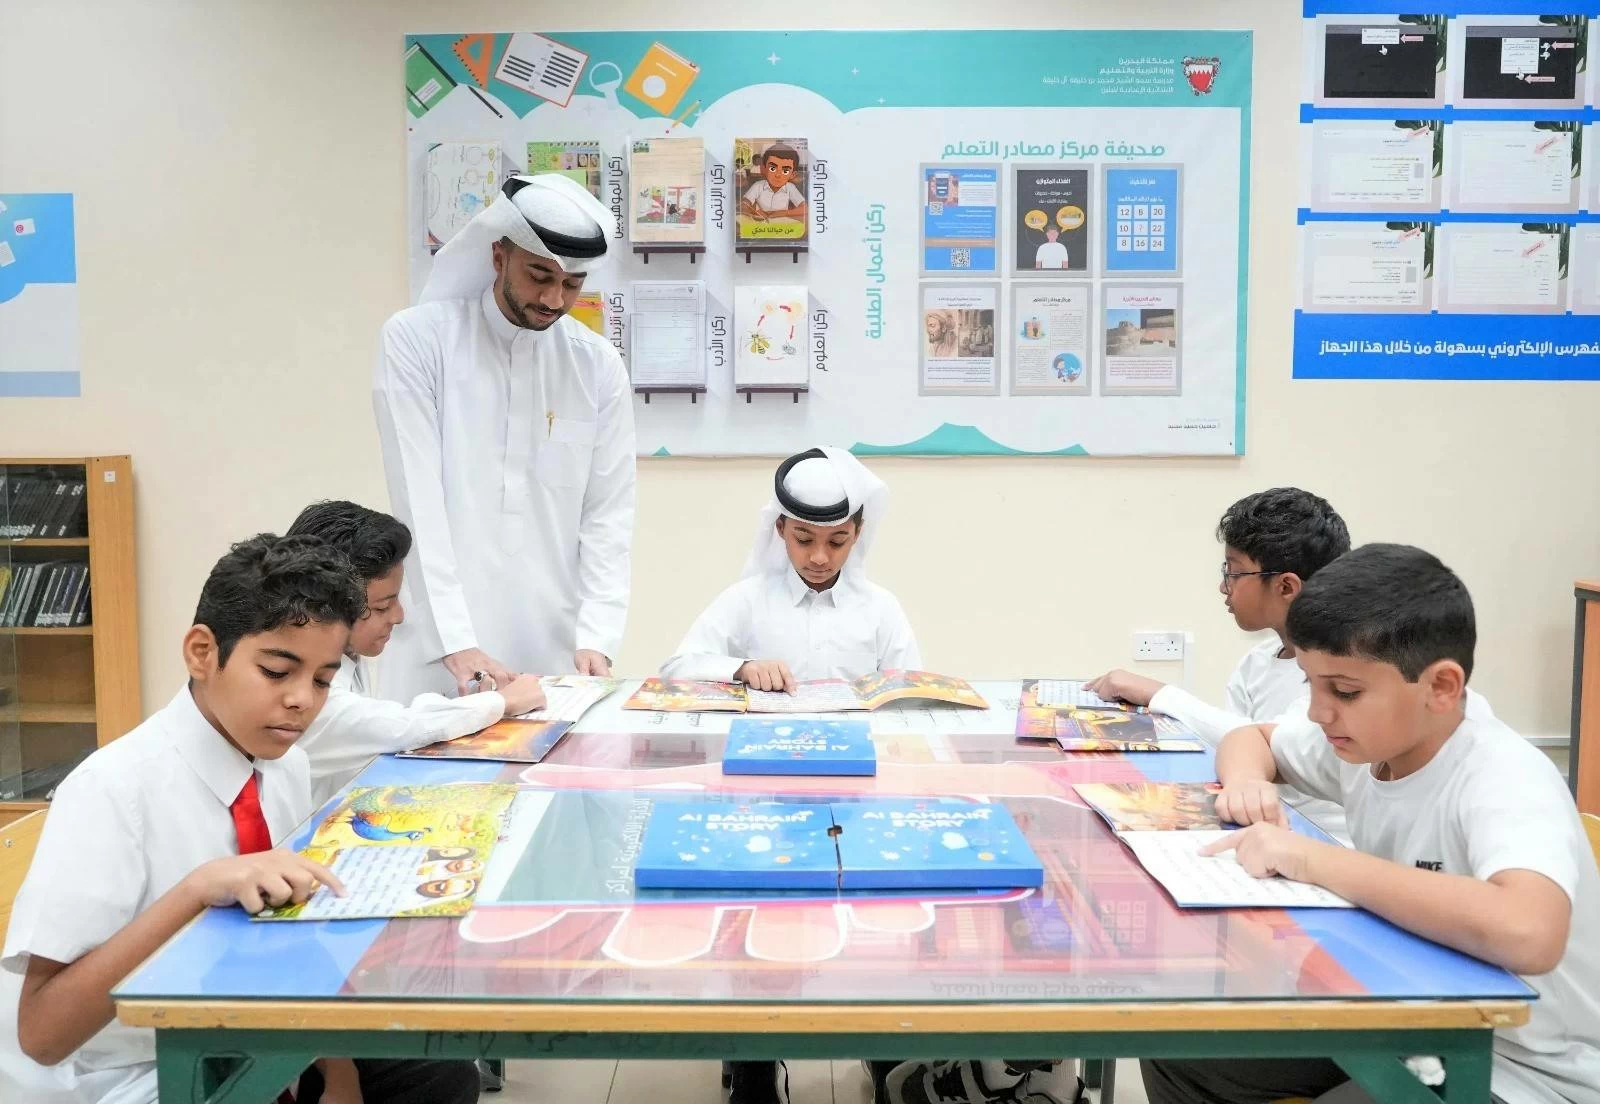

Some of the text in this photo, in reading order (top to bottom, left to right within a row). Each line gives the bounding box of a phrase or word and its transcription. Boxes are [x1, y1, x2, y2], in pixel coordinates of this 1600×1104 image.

[941, 141, 1165, 160] صحيفة مركز مصادر التعلم
[609, 156, 624, 177] ركن
[711, 164, 726, 185] ركن
[813, 159, 828, 233] ركن الحاسوب
[1120, 208, 1130, 216] 12
[1153, 208, 1163, 216] 20
[1152, 240, 1162, 248] 24
[861, 204, 887, 339] ركن أعمال الطلبة
[610, 292, 625, 313] ركن
[705, 316, 727, 367] ركن الأدب
[813, 309, 828, 371] ركن العلوم
[1319, 340, 1600, 358] فهرس الإلكتروني بسهولة من خلال هذا الجهاز
[679, 813, 808, 822] AI BAHRAIN
[862, 811, 990, 820] AI BAHRAIN
[892, 819, 965, 827] STORY
[705, 822, 780, 831] STORY
